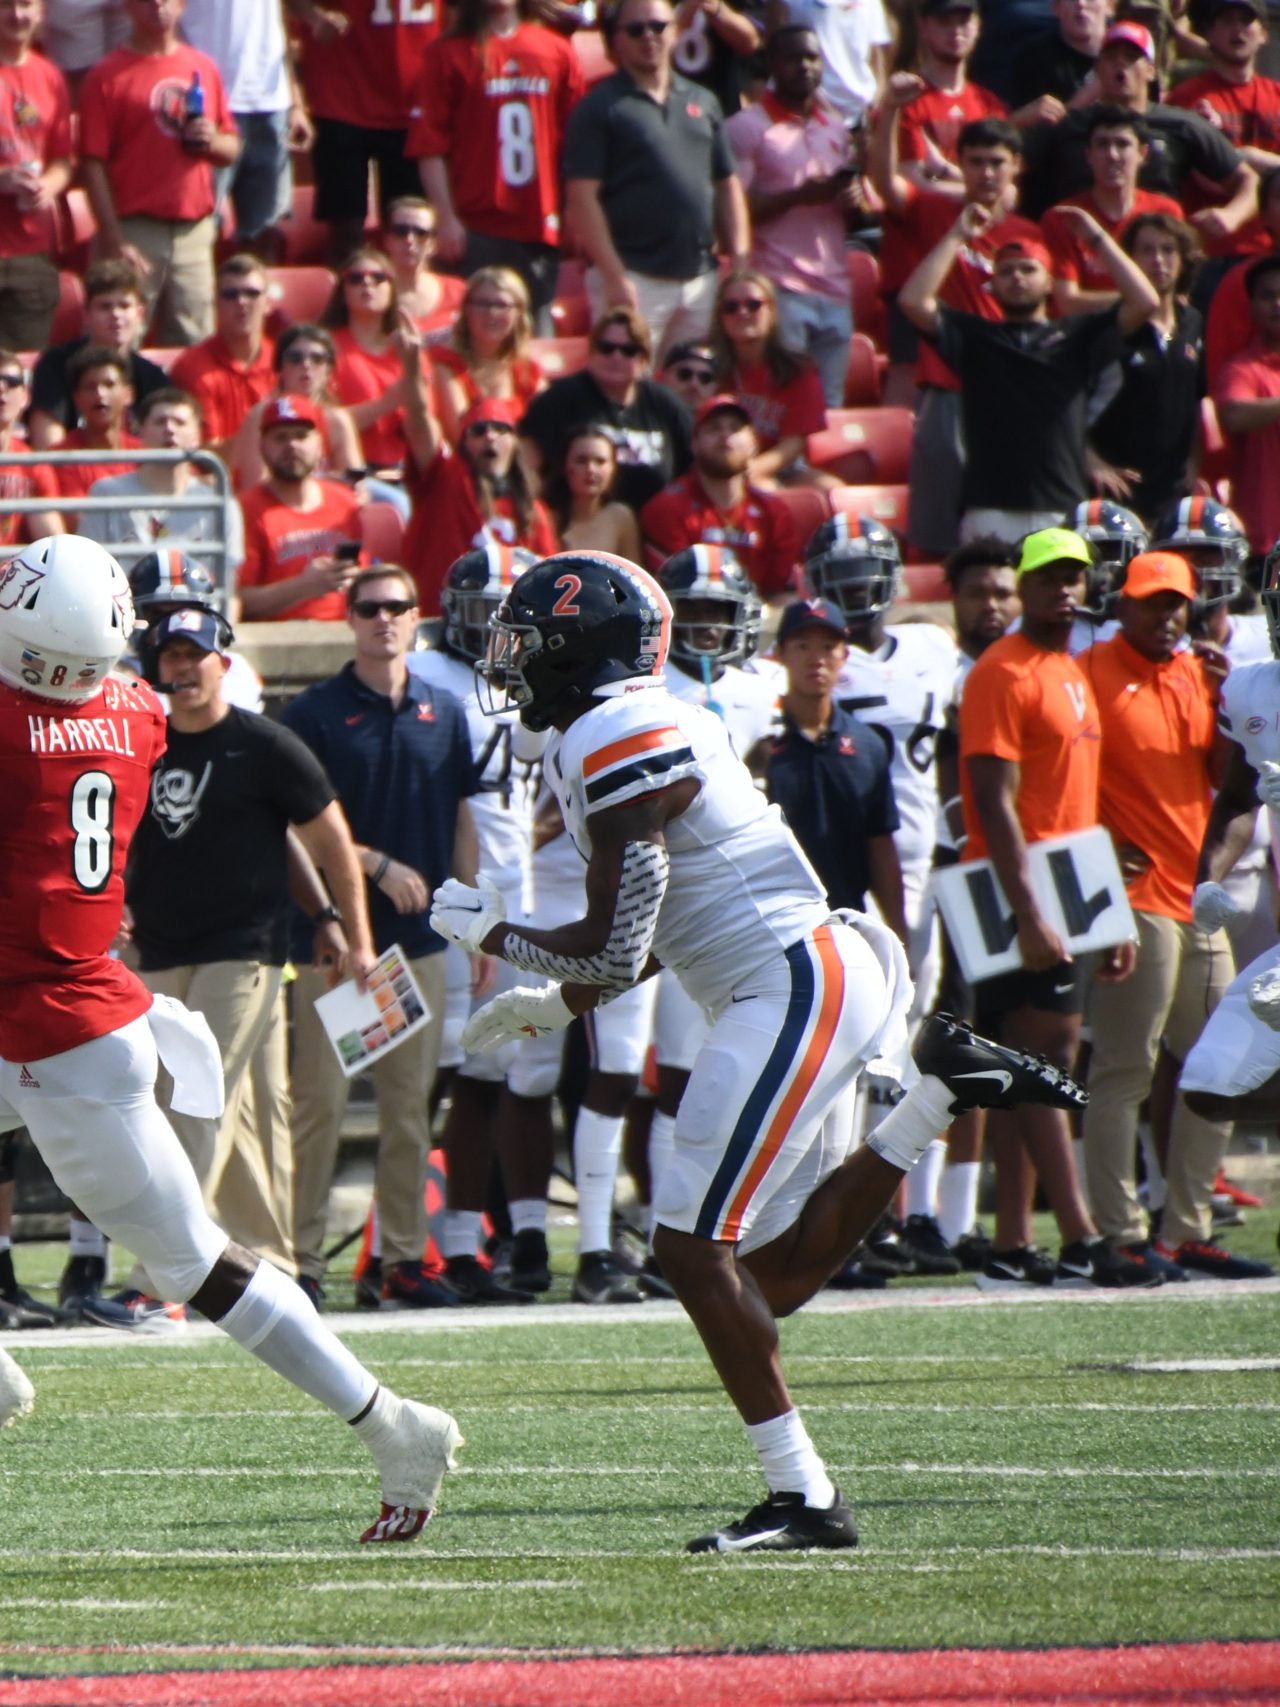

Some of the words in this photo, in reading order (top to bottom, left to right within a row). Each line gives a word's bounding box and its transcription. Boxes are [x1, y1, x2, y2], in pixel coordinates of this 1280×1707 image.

[498, 101, 536, 185] 8
[552, 574, 582, 617] 2
[49, 664, 68, 687] 8
[27, 714, 135, 757] HARRELL
[70, 769, 116, 894] 8
